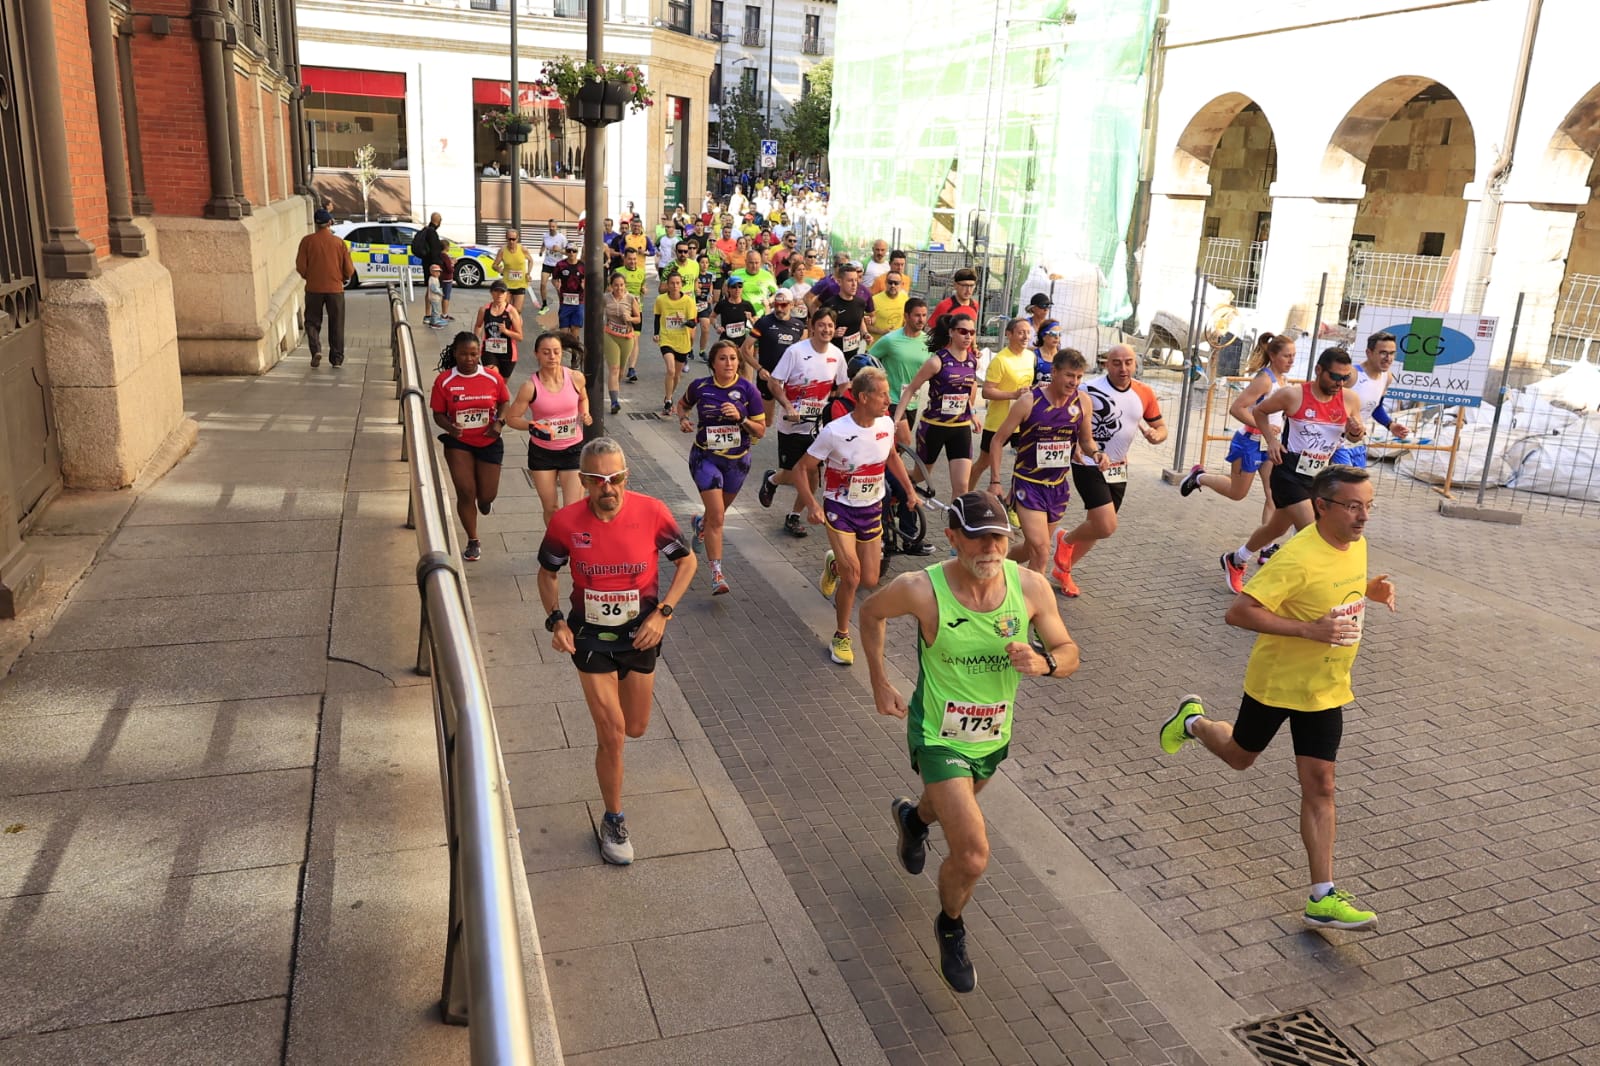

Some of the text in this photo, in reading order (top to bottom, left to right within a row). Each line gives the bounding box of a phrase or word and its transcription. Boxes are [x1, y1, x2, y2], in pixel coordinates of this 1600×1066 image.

[376, 264, 403, 273] Polic
[1399, 333, 1445, 357] CG
[1391, 373, 1470, 391] NGESA XXI
[806, 406, 821, 416] 300
[464, 413, 482, 423] 267
[557, 425, 569, 434] 28
[715, 433, 734, 443] 215
[1045, 450, 1064, 460] 297
[1108, 467, 1122, 477] 238
[861, 483, 874, 493] 57
[601, 603, 622, 616] 36
[946, 702, 1006, 716] bedunia
[959, 716, 993, 732] 173
